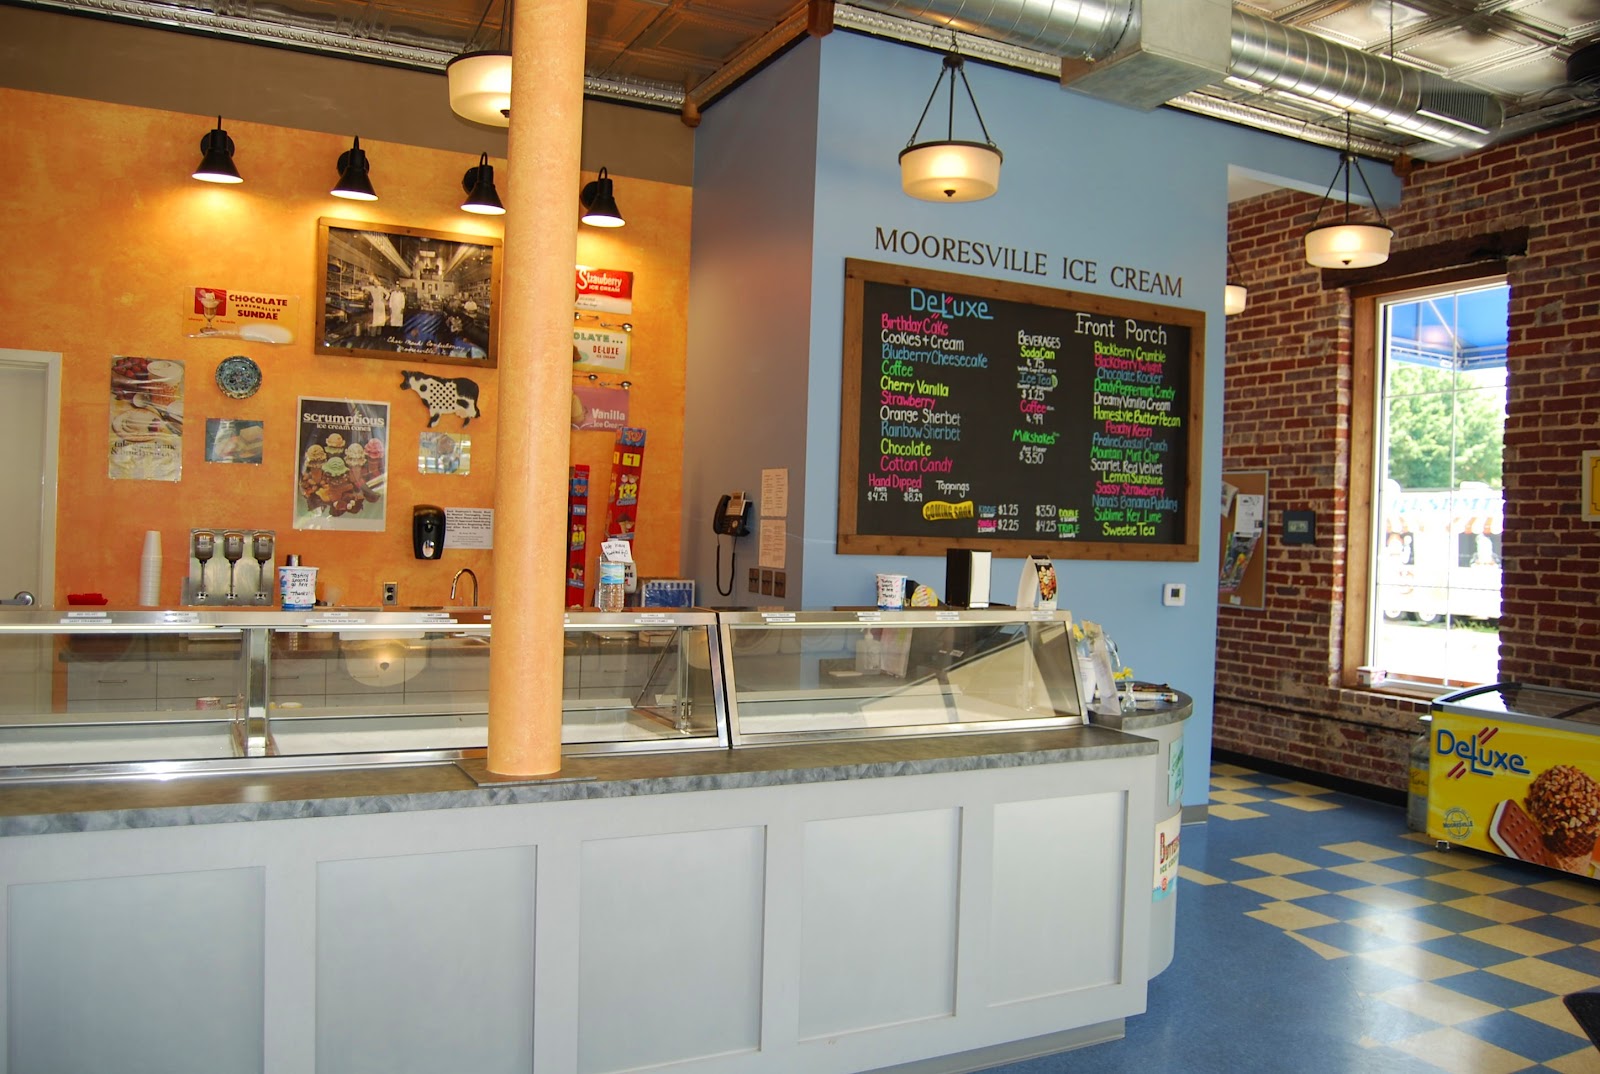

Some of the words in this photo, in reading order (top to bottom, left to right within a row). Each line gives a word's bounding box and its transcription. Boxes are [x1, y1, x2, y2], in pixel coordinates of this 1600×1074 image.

[875, 227, 1047, 276] MOORESVILLE
[1062, 257, 1097, 284] ICE
[1110, 266, 1183, 298] CREAM
[577, 269, 622, 290] Strawberry
[229, 294, 288, 306] CHOCOLATE
[235, 304, 281, 312] MARSHMALLOW
[911, 288, 994, 319] DeLuxe
[237, 309, 278, 320] SUNDAE
[881, 313, 922, 334] Birthday
[923, 317, 949, 336] Cake
[1074, 313, 1116, 338] Front
[1125, 319, 1167, 345] Porch
[573, 331, 610, 342] OLATE
[881, 329, 922, 347] Cookies
[930, 335, 965, 352] Cream
[592, 345, 620, 356] DE-LUXE
[882, 342, 931, 363] Blueberry
[931, 350, 989, 369] Cheesecake
[1020, 345, 1040, 358] Soda
[1040, 347, 1055, 360] Can
[1093, 340, 1136, 360] Blackberry
[1135, 346, 1167, 363] Crumble
[881, 360, 914, 377] Coffee
[1097, 366, 1136, 382] Chocolate
[880, 376, 915, 395] Cherry
[916, 380, 949, 397] Vanilla
[1020, 371, 1036, 384] Ice
[1037, 374, 1052, 385] Tea
[881, 390, 936, 409] Strawberry
[1094, 392, 1122, 408] Dreamy
[1121, 395, 1147, 409] Vanilla
[1146, 397, 1171, 411] Cream
[1155, 385, 1176, 401] Candy
[592, 408, 626, 421] Vanilla
[1020, 400, 1047, 413] Coffee
[303, 410, 385, 427] scrumptious
[590, 420, 603, 428] Ice
[880, 405, 919, 423] Orange
[922, 408, 961, 426] Sherbet
[1093, 405, 1133, 422] Homestyle
[1134, 409, 1159, 426] Butter
[1158, 411, 1181, 427] Pecan
[881, 421, 923, 439] Rainbow
[922, 424, 961, 441] Sherbet
[1012, 429, 1056, 445] Milkshakes
[1105, 420, 1132, 438] Peachy
[1131, 424, 1153, 437] Keen
[881, 438, 932, 456] Chocolate
[1144, 438, 1168, 452] Crunch
[881, 455, 918, 472] Cotton
[920, 456, 954, 473] Candy
[1090, 458, 1121, 472] Scarlet
[1123, 460, 1138, 474] Red
[1139, 462, 1164, 475] Velvet
[868, 473, 891, 487] Hand
[892, 474, 923, 492] Dipped
[1103, 471, 1131, 484] Lemon
[1130, 472, 1164, 486] Sunshine
[618, 483, 638, 499] 132
[936, 480, 970, 498] Toppings
[1095, 481, 1121, 496] Sassy
[1121, 482, 1166, 498] Strawberry
[574, 506, 586, 514] TWIN
[1092, 494, 1119, 508] Nana's
[1120, 496, 1151, 510] Banana
[1150, 496, 1179, 513] Pudding
[1094, 507, 1124, 522] Sublime
[1126, 508, 1141, 522] Key
[1143, 509, 1162, 523] Lime
[572, 530, 586, 543] 60
[1057, 523, 1080, 534] TRIPLE
[1102, 522, 1138, 536] Sweetie
[1137, 522, 1156, 537] Tea
[1437, 729, 1531, 776] DeLuxe
